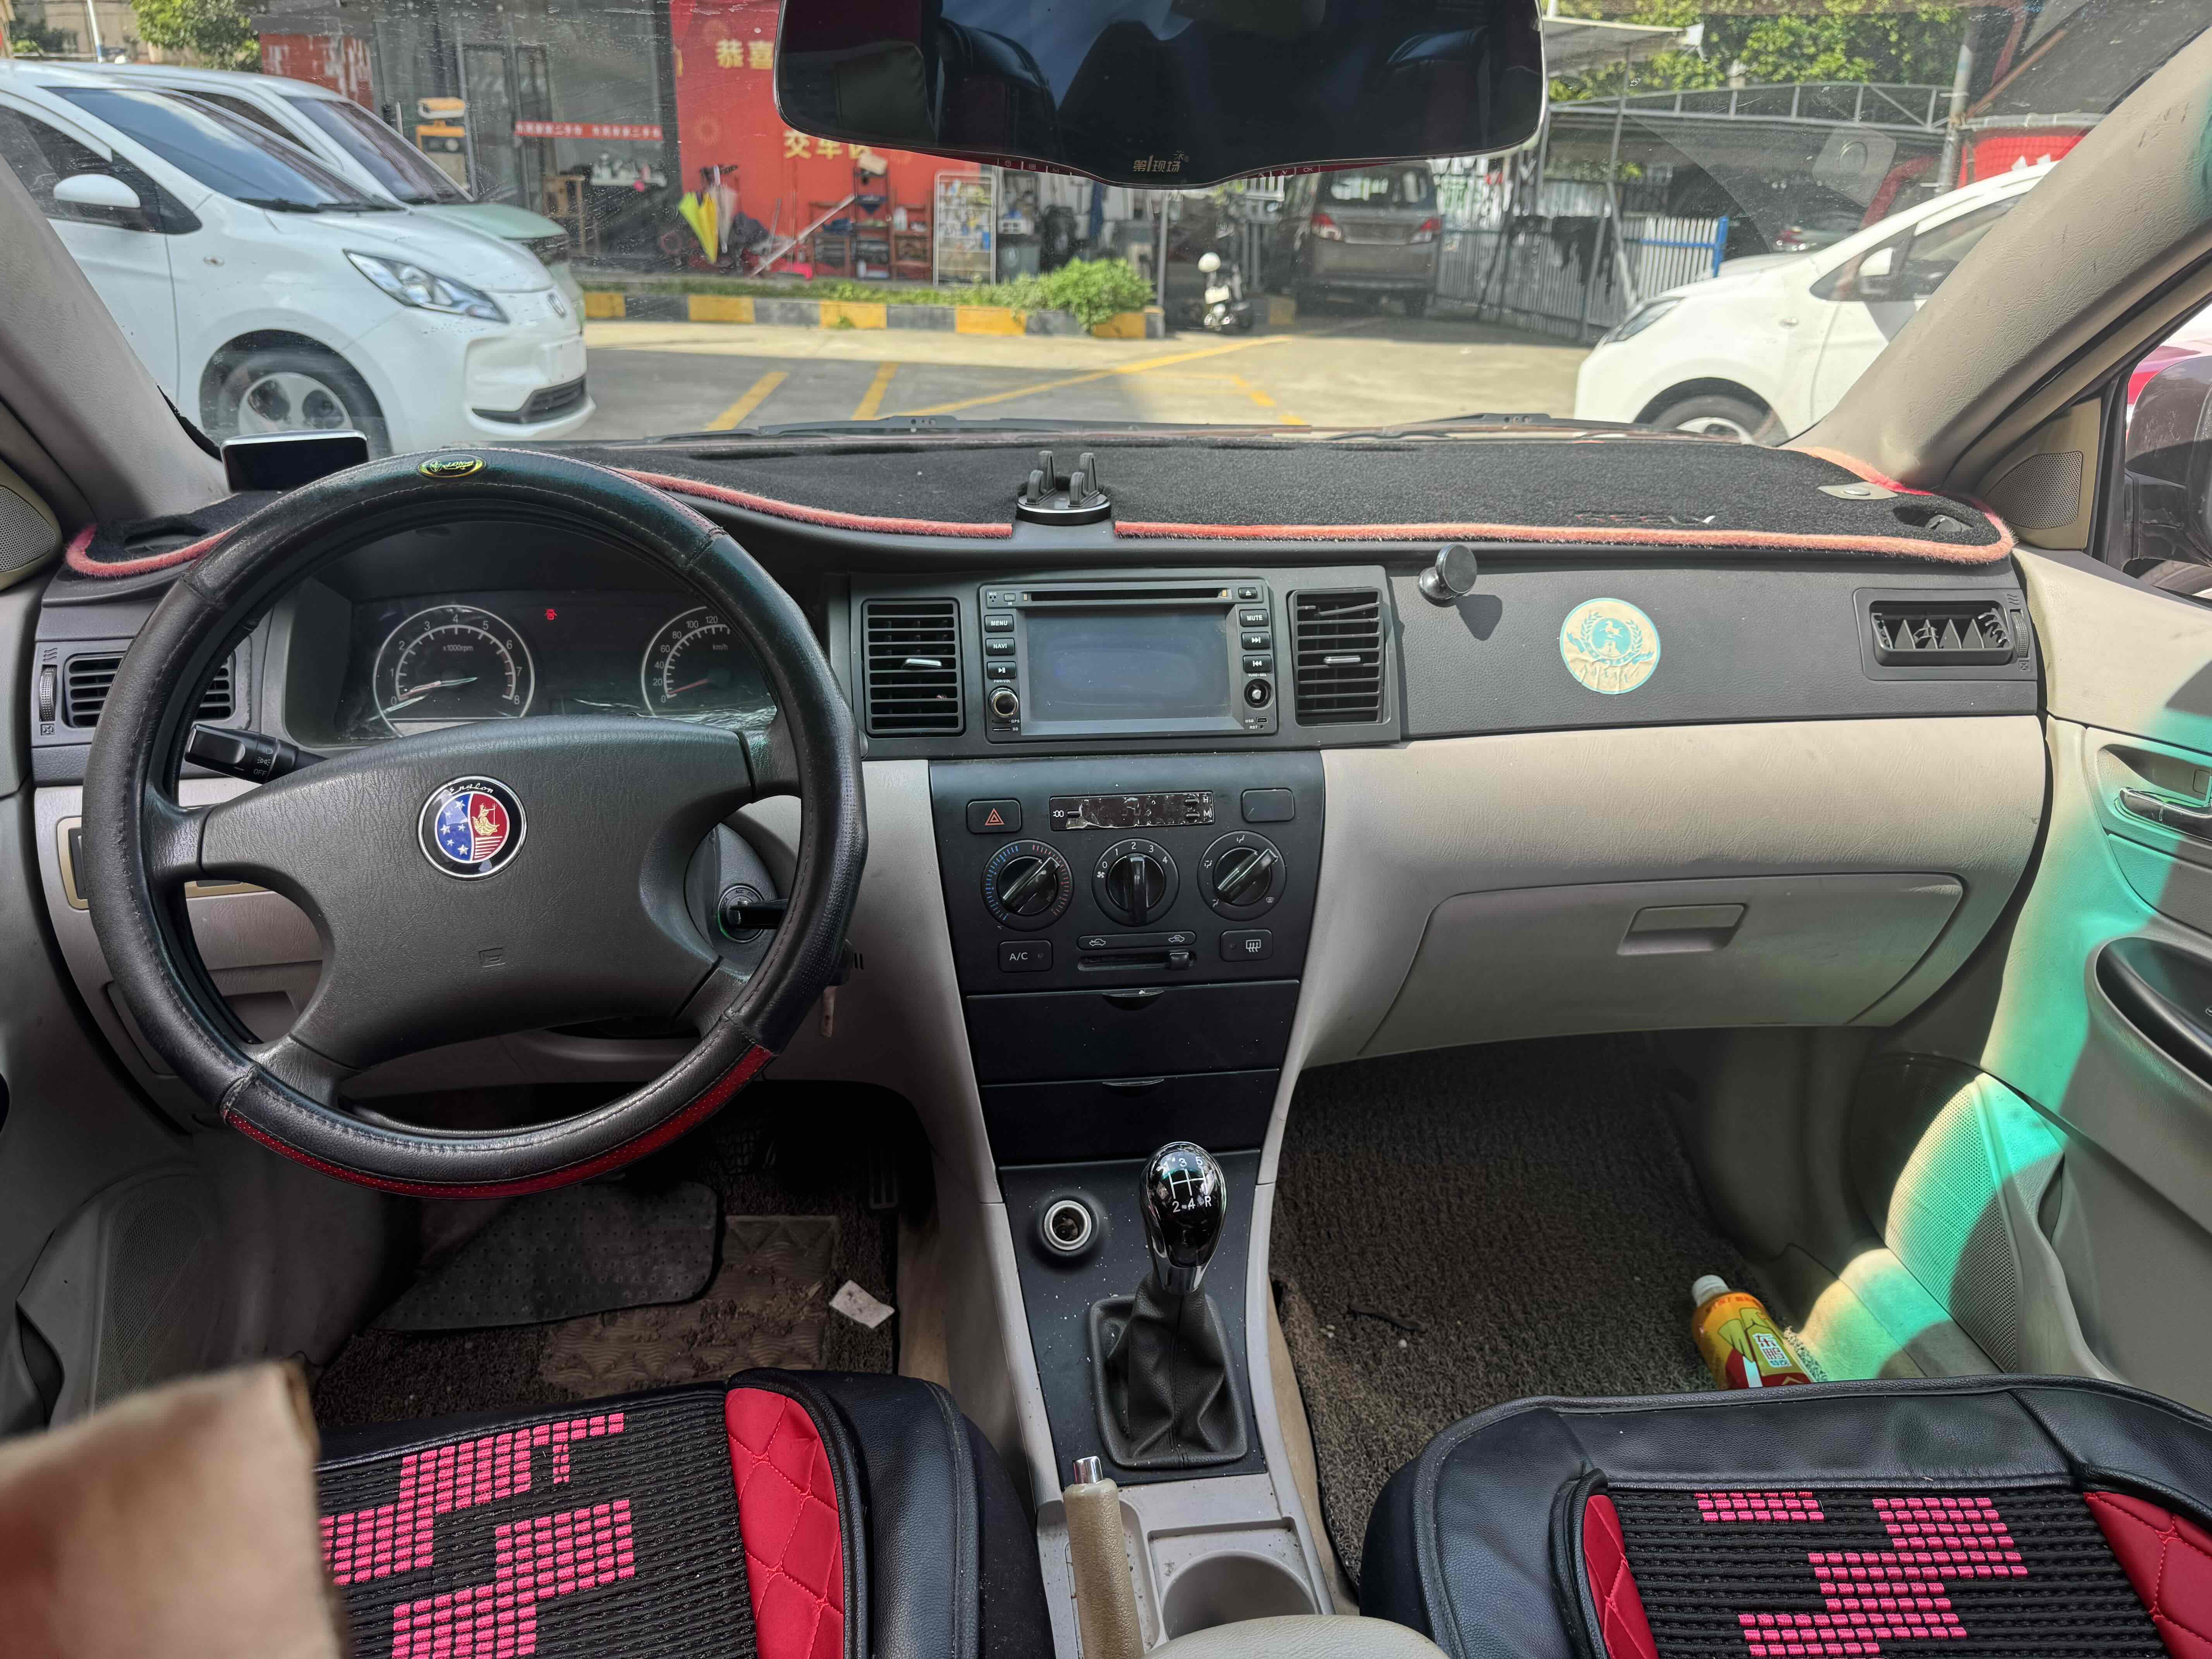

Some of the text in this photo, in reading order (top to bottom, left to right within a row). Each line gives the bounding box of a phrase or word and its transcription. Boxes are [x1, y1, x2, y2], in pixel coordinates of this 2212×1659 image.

[715, 38, 774, 70] 恭喜
[453, 614, 459, 623] 4
[705, 616, 718, 624] 120
[424, 621, 430, 631] 3
[483, 621, 489, 630] 5
[686, 620, 699, 629] 100
[672, 631, 682, 639] 80
[398, 641, 405, 651] 2
[507, 640, 513, 649] 6
[660, 644, 670, 653] 60
[654, 661, 665, 669] 40
[390, 668, 394, 677] 1
[516, 667, 522, 676] 7
[653, 678, 663, 686] 20
[390, 697, 397, 705] 0
[514, 696, 520, 705] 8
[661, 695, 666, 703] 0
[253, 768, 267, 777] OFF
[1131, 842, 1137, 850] 2
[1114, 848, 1119, 856] 1
[1009, 950, 1028, 961] A/C
[1178, 1158, 1187, 1167] 3
[1195, 1156, 1203, 1165] 5
[1188, 1197, 1196, 1210] 4
[1204, 1195, 1212, 1207] R
[1172, 1201, 1181, 1212] 2
